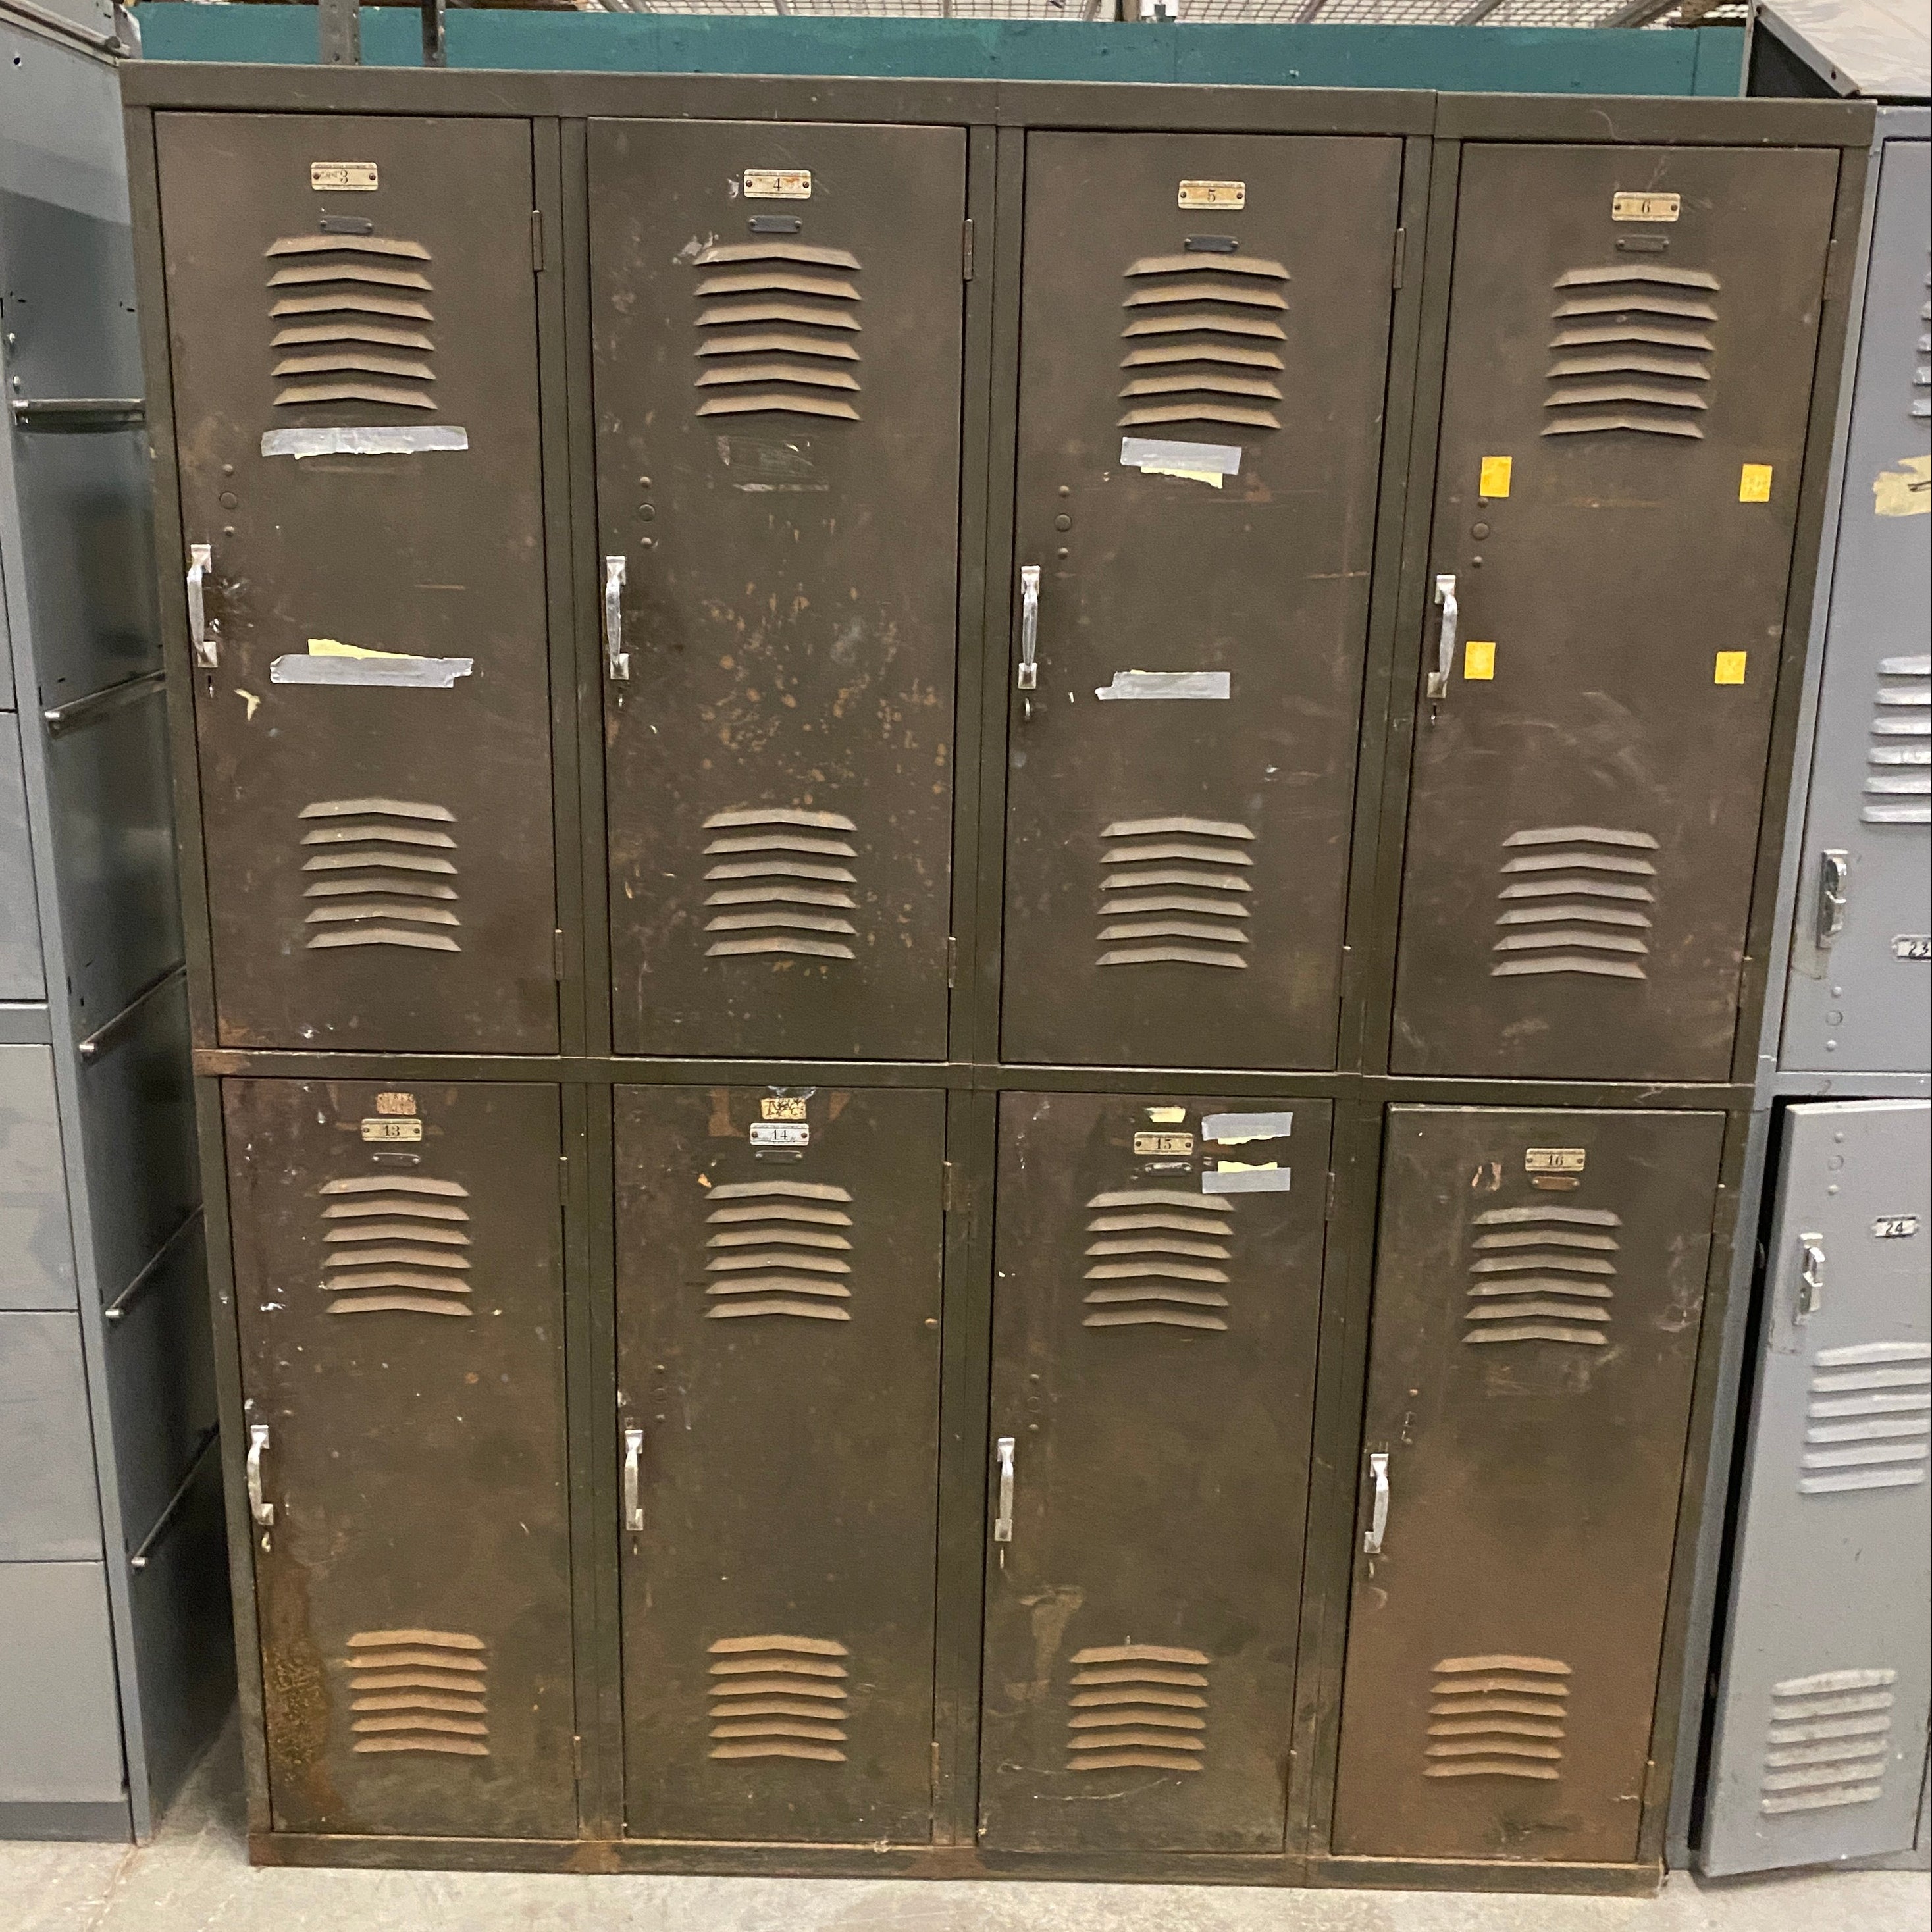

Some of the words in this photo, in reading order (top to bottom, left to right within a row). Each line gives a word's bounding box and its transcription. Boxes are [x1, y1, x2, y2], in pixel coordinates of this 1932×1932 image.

[340, 169, 348, 184] 3
[773, 178, 782, 192] 4
[1208, 188, 1216, 203] 5
[1642, 200, 1651, 215] 6
[1908, 941, 1929, 957] 23
[383, 1125, 400, 1136] 13
[772, 1129, 788, 1140] 14
[1157, 1139, 1172, 1150] 15
[1548, 1154, 1563, 1167] 16
[1885, 1220, 1904, 1236] 24
